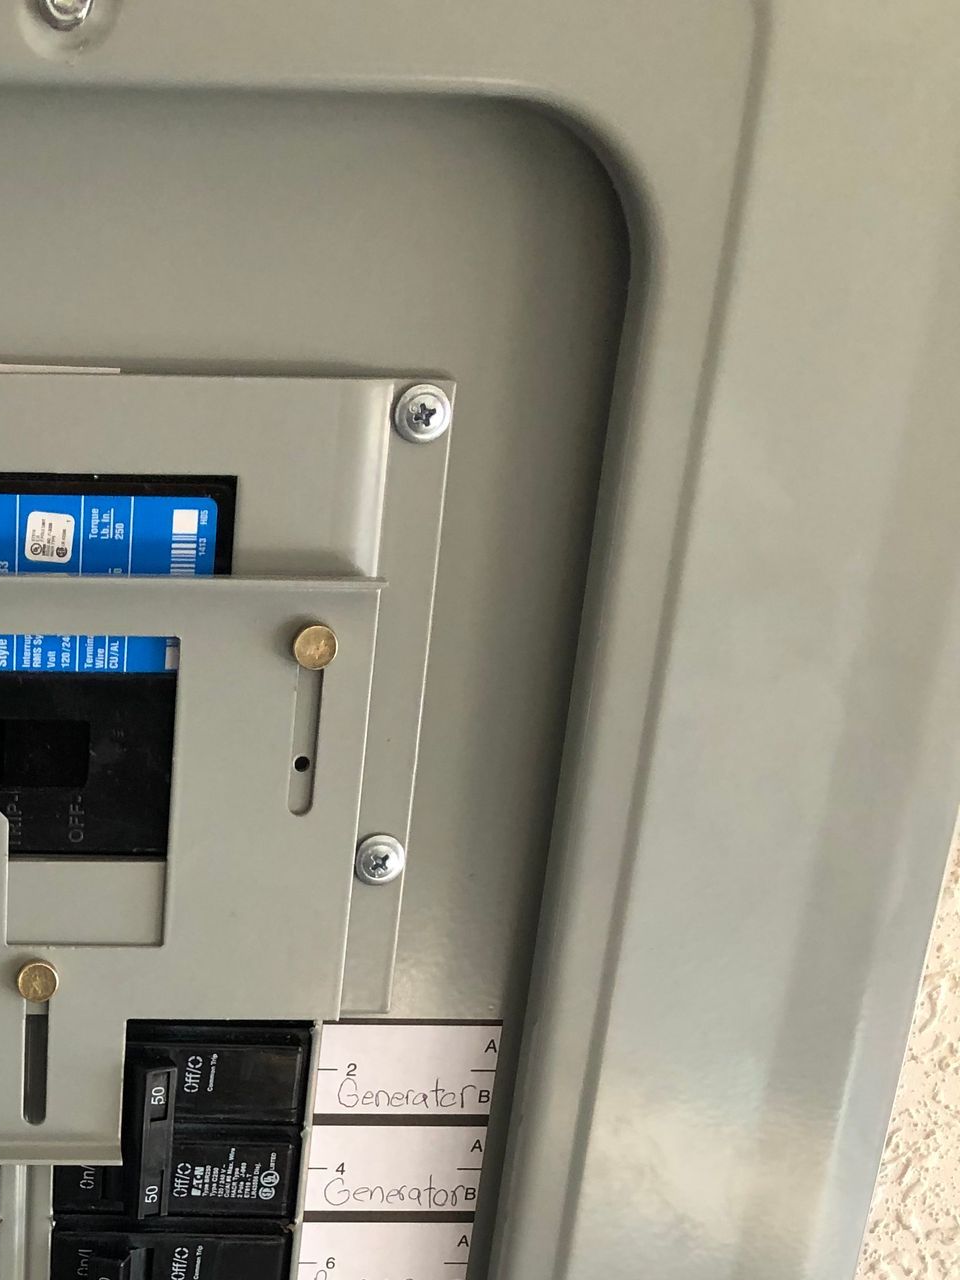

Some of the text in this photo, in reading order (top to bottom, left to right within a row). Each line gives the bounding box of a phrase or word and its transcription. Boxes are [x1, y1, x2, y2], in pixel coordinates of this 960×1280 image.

[88, 508, 100, 540] Torque
[100, 525, 109, 539] Lb.
[114, 522, 124, 540] 250
[198, 537, 207, 555] 1413
[33, 645, 41, 668] RMS
[47, 651, 56, 668] Volt
[95, 648, 104, 668] Wire
[109, 641, 119, 669] CU/AL
[69, 804, 84, 842] OFF
[346, 1063, 357, 1077] 2
[151, 1086, 165, 1106] 50
[336, 1077, 478, 1109] Generator
[336, 1162, 346, 1175] 4
[145, 1184, 158, 1204] 50
[323, 1174, 465, 1208] Generator
[326, 1257, 336, 1270] 6
